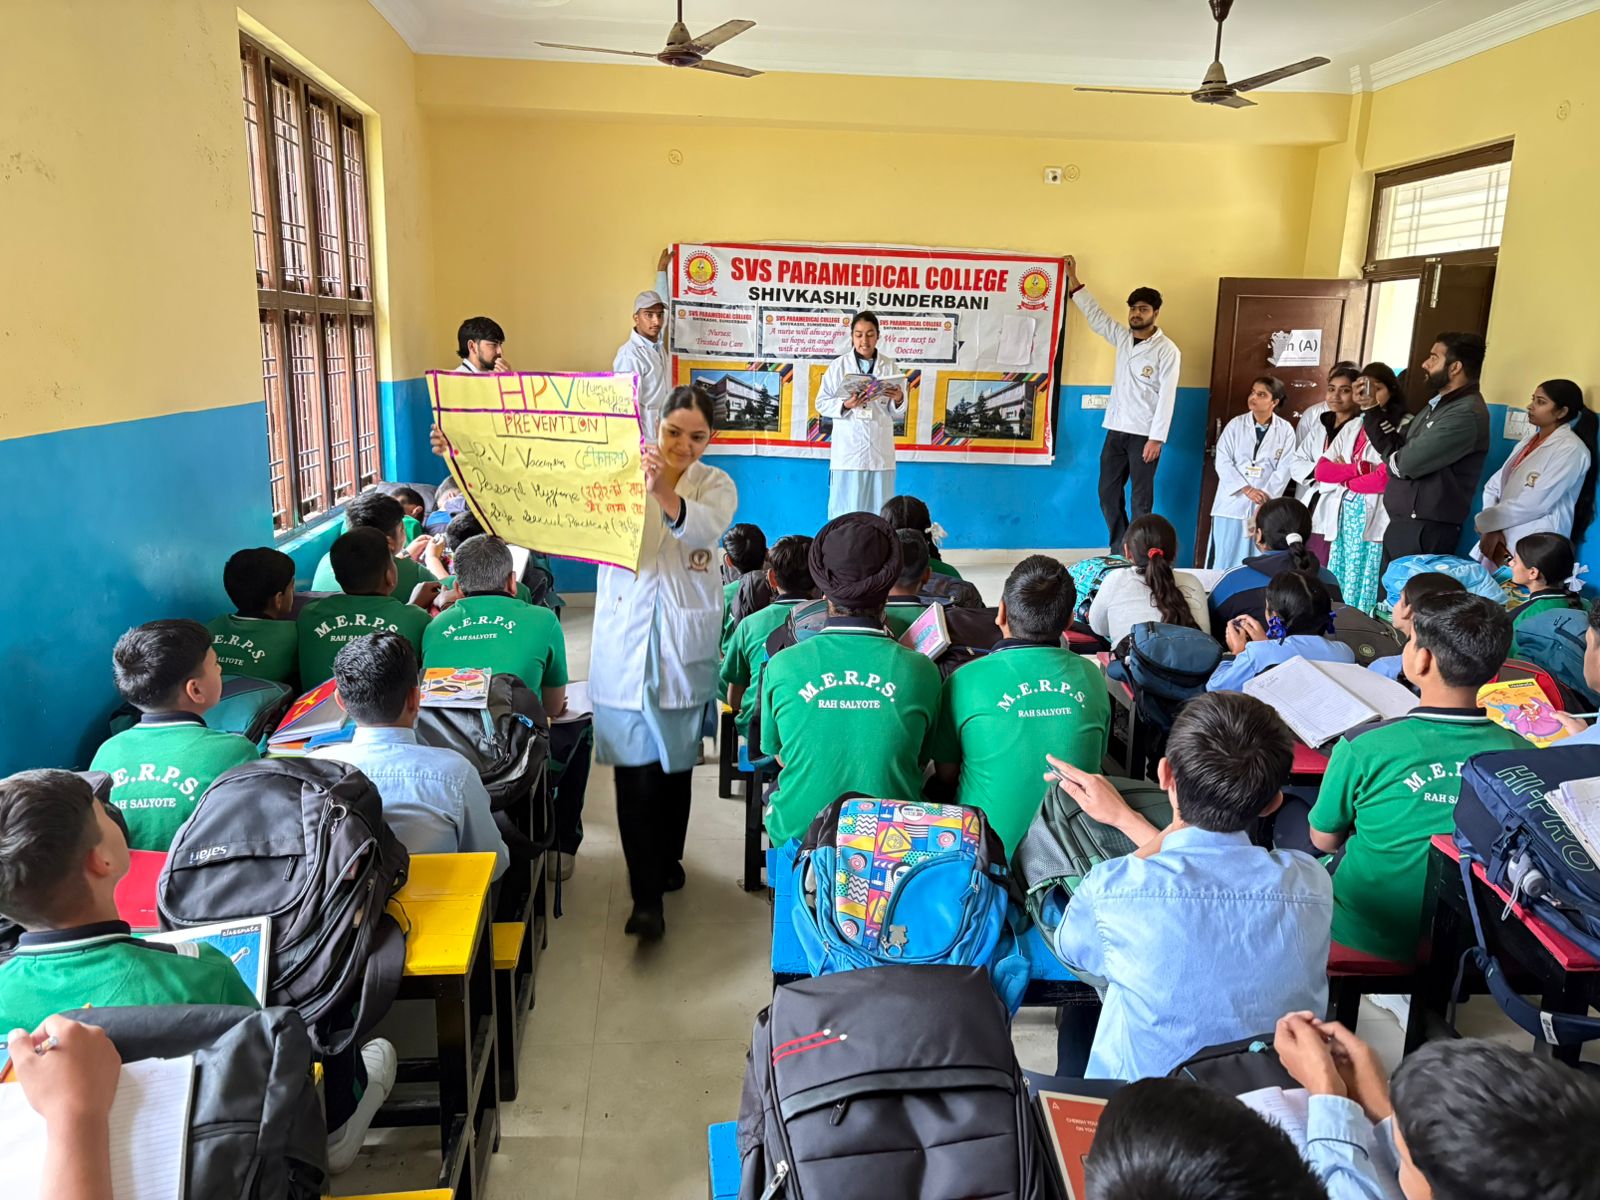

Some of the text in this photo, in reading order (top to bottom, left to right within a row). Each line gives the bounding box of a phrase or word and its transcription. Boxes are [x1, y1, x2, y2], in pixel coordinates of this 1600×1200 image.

[731, 257, 772, 282] SVS
[777, 259, 920, 290] PARAMEDICAL
[925, 266, 1009, 293] COLLEGE
[748, 287, 989, 310] SHIVKASHI, SUNDERBANI
[809, 328, 832, 337] always
[832, 330, 846, 339] give
[884, 334, 897, 342] We
[790, 336, 806, 345] hope,
[817, 337, 834, 346] angel
[1298, 339, 1318, 353] (A)
[894, 346, 923, 355] Doctors
[497, 375, 575, 409] HPV
[504, 414, 599, 435] PREVENTION
[442, 615, 517, 639] M.E.R.P.S.
[467, 632, 499, 640] SALYOTE
[797, 670, 897, 703] M.E.R.P.S.
[996, 679, 1086, 713] M.E.R.P.S.
[818, 699, 881, 709] RAH SALYOTE
[1018, 707, 1073, 718] RAH SALYOTE
[129, 797, 177, 809] SALYOTE
[1423, 792, 1447, 803] RAH
[222, 924, 260, 937] classmate
